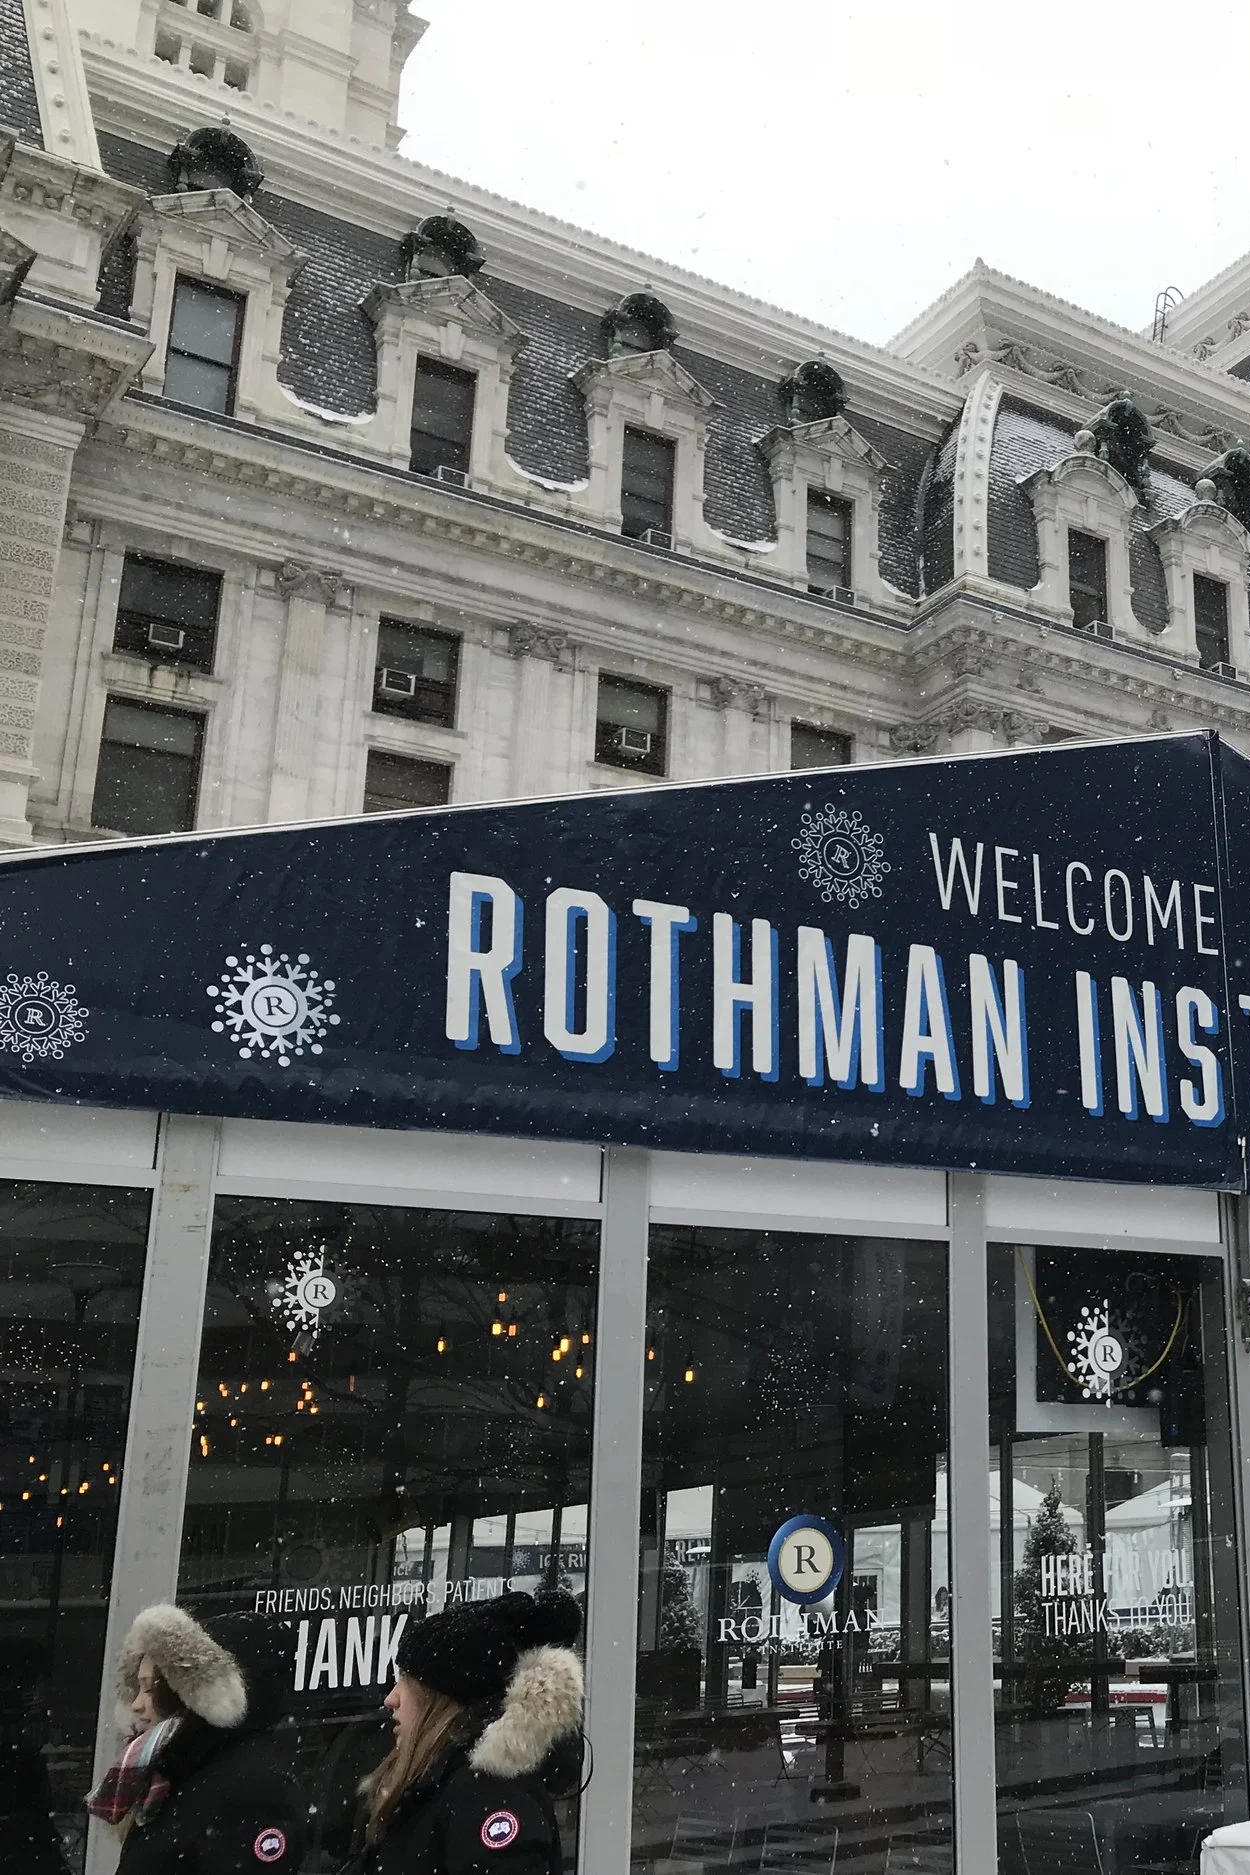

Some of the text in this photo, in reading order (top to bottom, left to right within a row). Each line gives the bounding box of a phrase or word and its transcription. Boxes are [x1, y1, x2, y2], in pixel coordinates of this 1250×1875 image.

[928, 831, 1220, 957] WELCOME
[263, 996, 290, 1017] R
[445, 870, 1030, 1110] ROTHMAN
[793, 1545, 822, 1575] R
[1041, 1553, 1095, 1597] HERE
[1102, 1551, 1141, 1593] FOR
[254, 1586, 335, 1613] FRIENDS.
[339, 1583, 437, 1610] NEIGHBORS.
[1041, 1598, 1120, 1637] THANKS
[1129, 1597, 1150, 1628] TO
